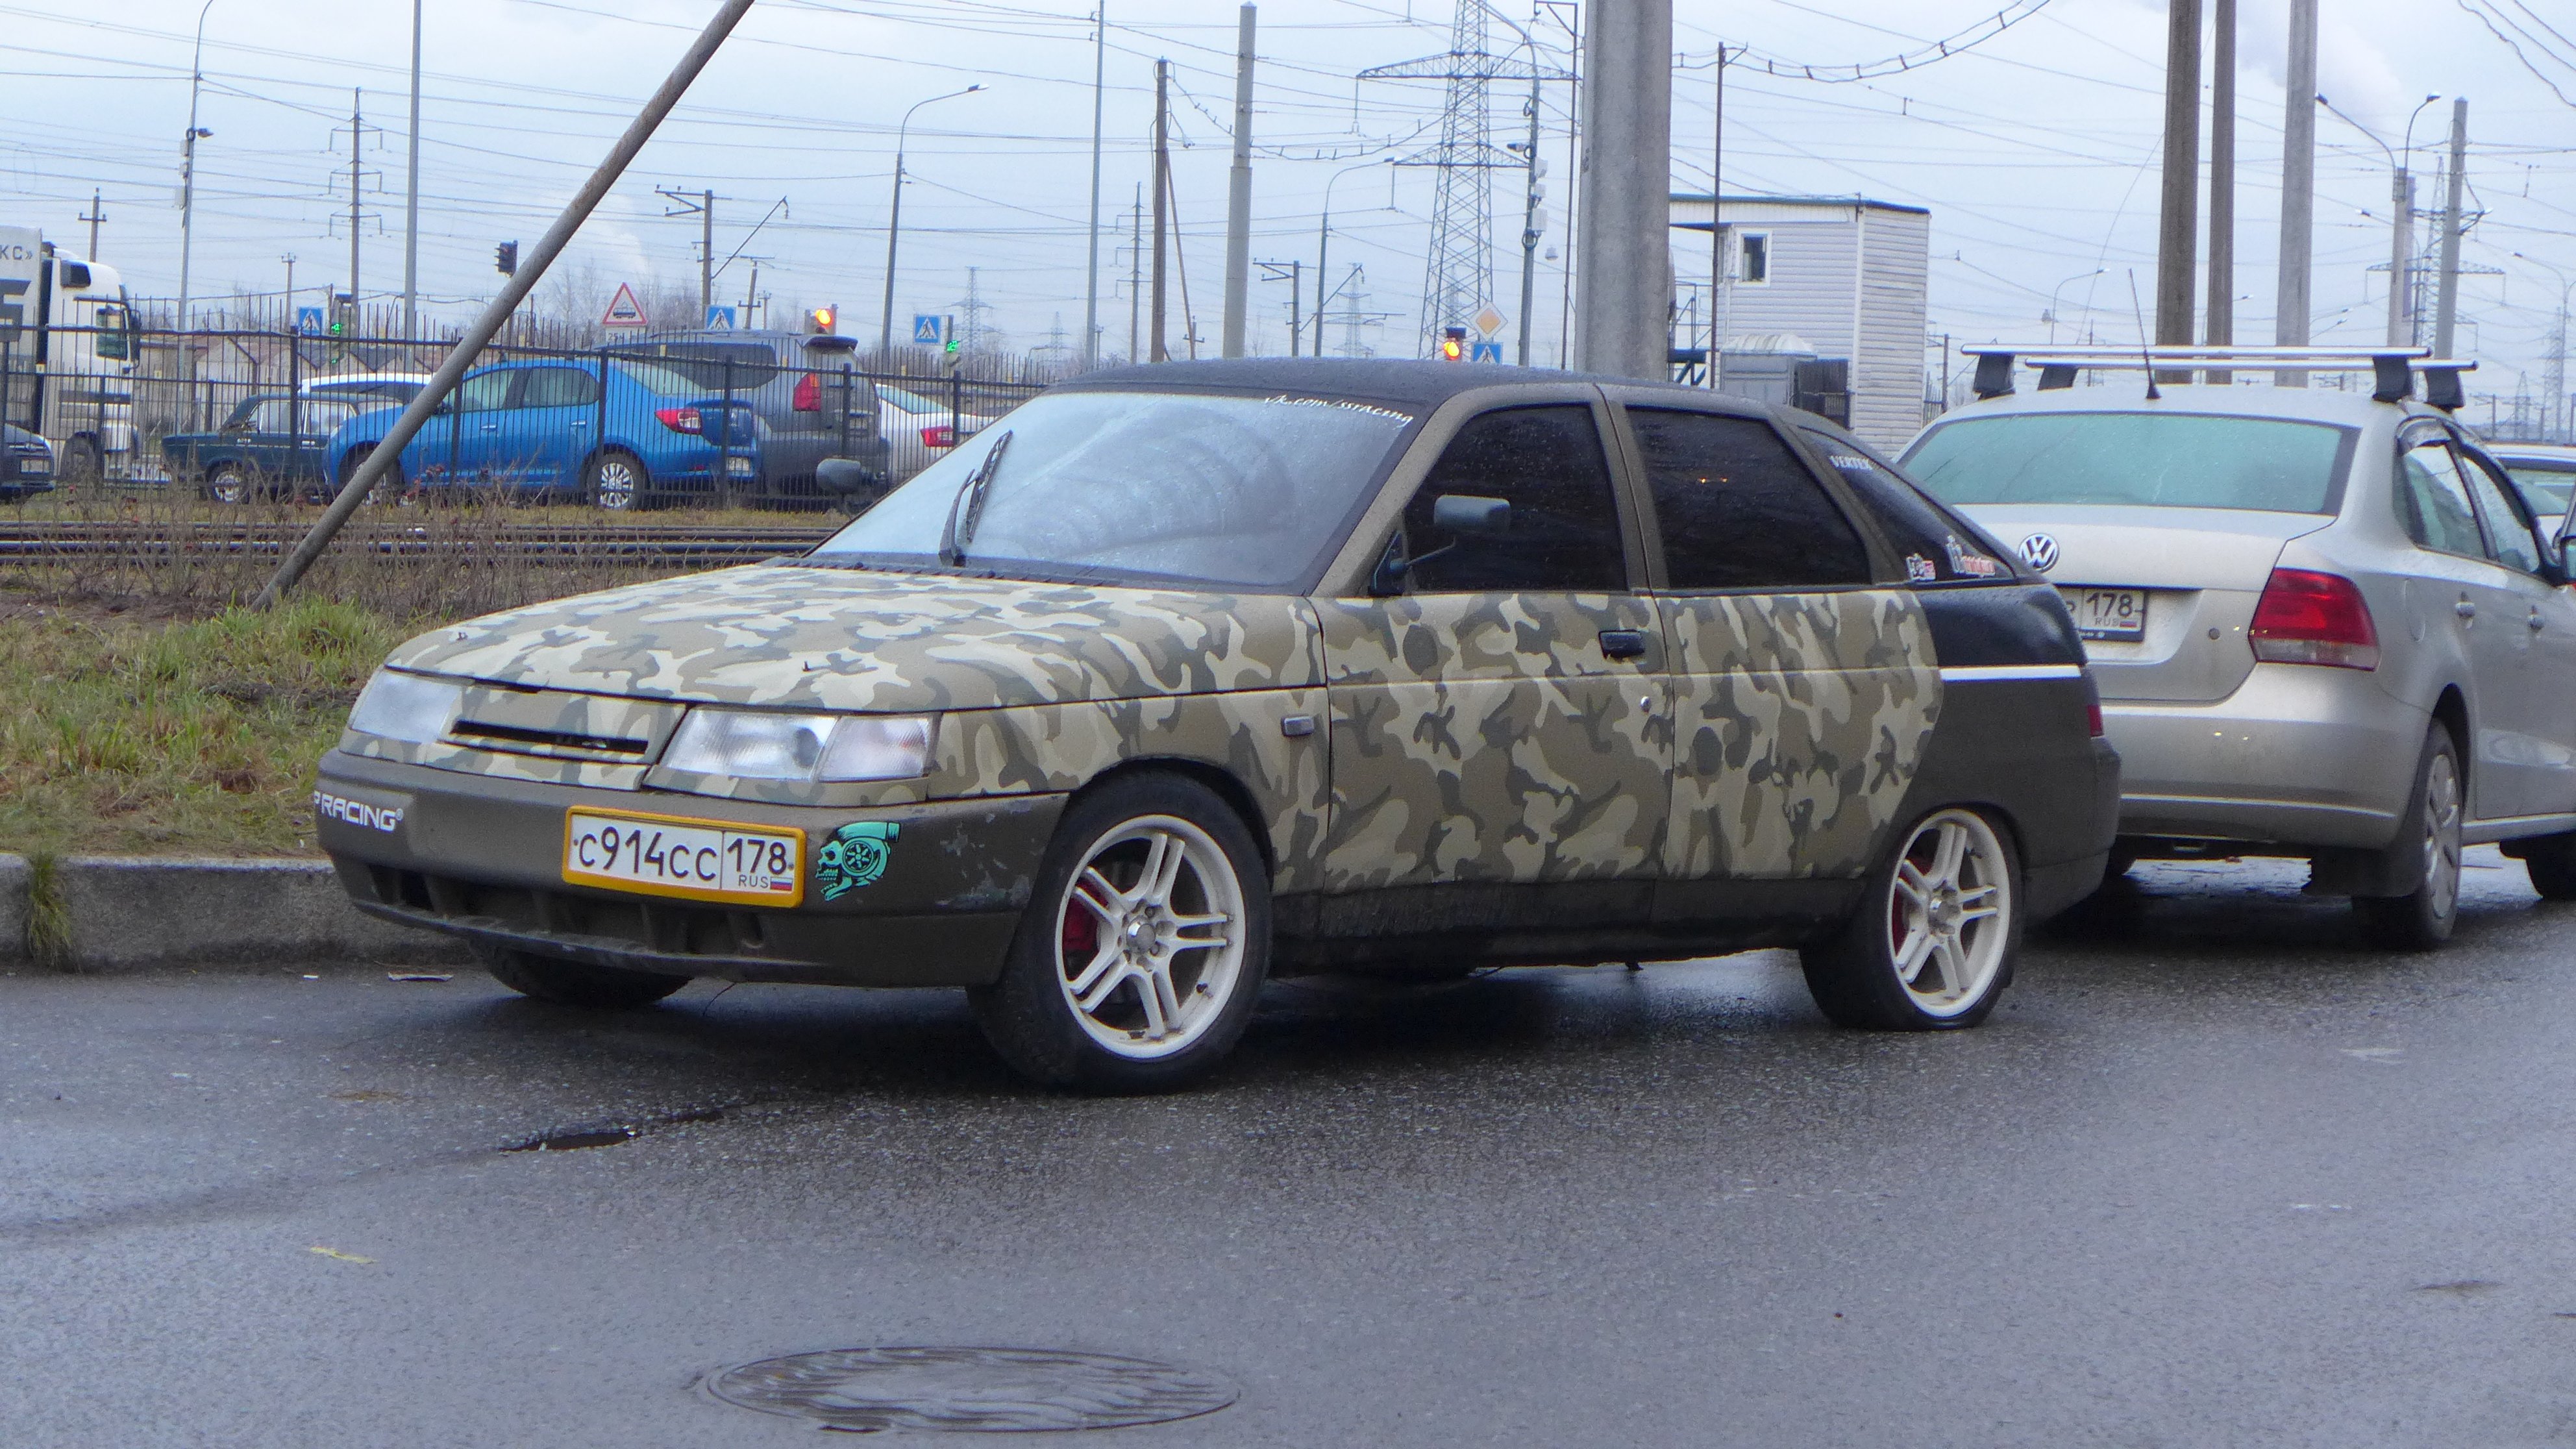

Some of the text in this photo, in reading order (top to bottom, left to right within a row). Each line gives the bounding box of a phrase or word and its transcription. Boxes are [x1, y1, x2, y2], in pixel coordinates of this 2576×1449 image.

[2086, 592, 2132, 617] 178
[727, 837, 787, 875] 178
[737, 874, 769, 889] RUS
